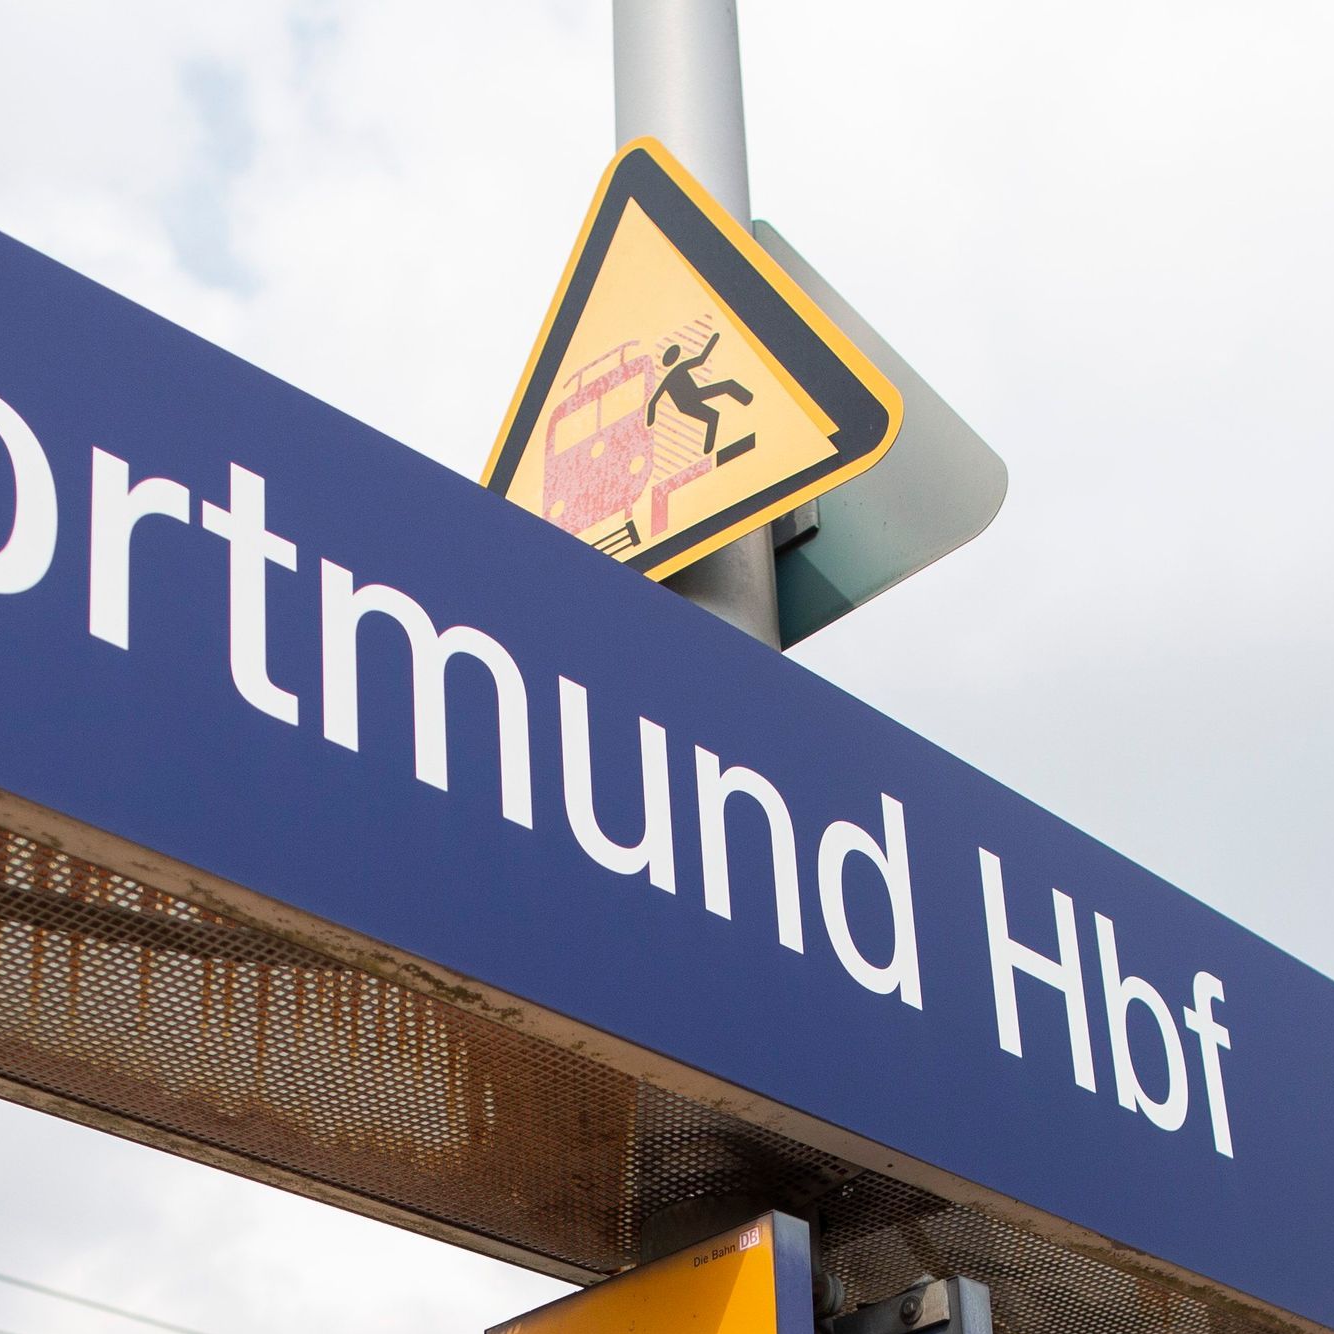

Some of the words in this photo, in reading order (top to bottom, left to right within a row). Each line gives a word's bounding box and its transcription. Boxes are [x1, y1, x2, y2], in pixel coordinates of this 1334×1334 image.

[979, 847, 1234, 1160] Hbf
[693, 1255, 709, 1268] Die
[711, 1244, 736, 1261] Bahn
[739, 1228, 759, 1250] DB
